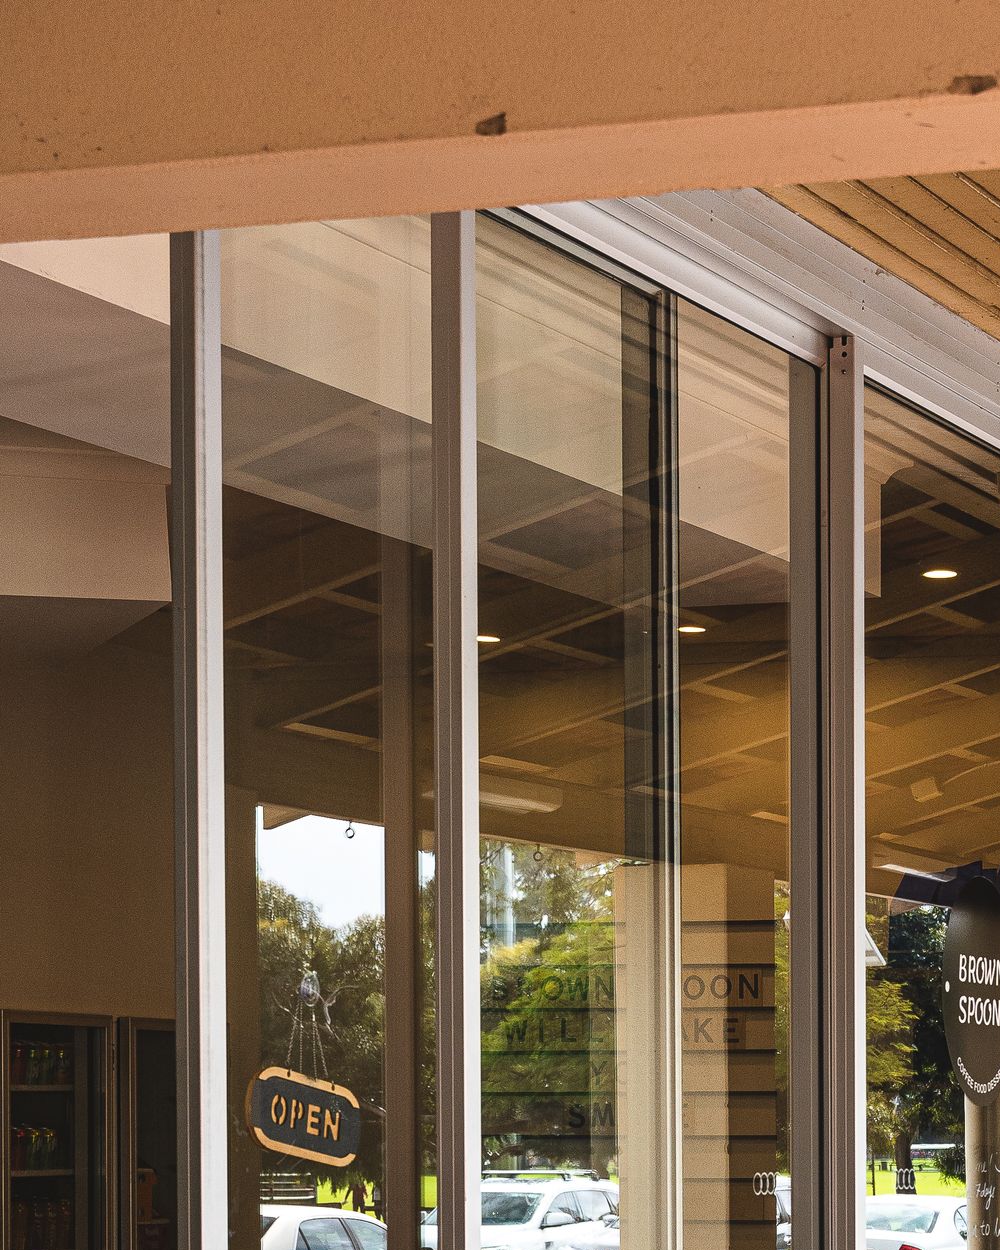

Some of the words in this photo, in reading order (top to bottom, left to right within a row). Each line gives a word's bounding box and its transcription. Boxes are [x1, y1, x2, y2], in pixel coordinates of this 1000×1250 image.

[958, 995, 1000, 1026] SPOON
[957, 1057, 975, 1089] COFFEE
[973, 1082, 988, 1094] FOOD
[271, 1094, 340, 1141] OPEN
